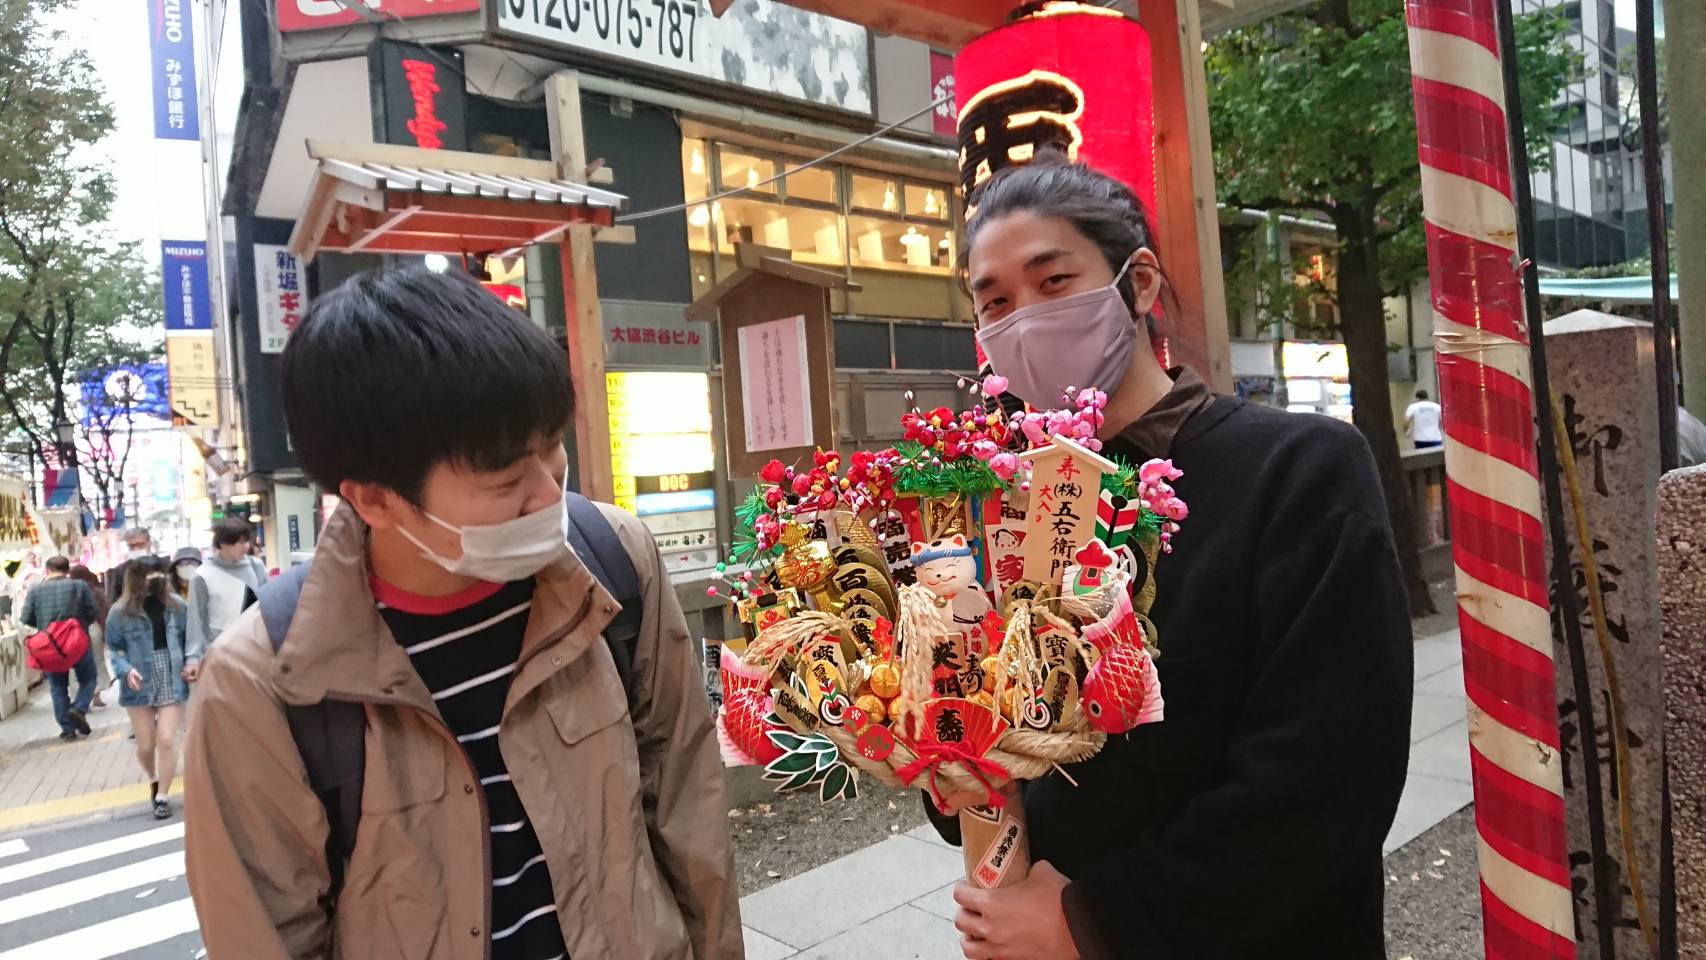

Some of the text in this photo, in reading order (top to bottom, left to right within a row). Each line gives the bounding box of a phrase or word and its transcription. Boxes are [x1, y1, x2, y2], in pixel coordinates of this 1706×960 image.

[165, 59, 185, 128] みずほ銀行
[165, 246, 204, 257] MIZUHO
[611, 327, 700, 345] 大協渋谷ビル
[1056, 455, 1080, 481] 寿
